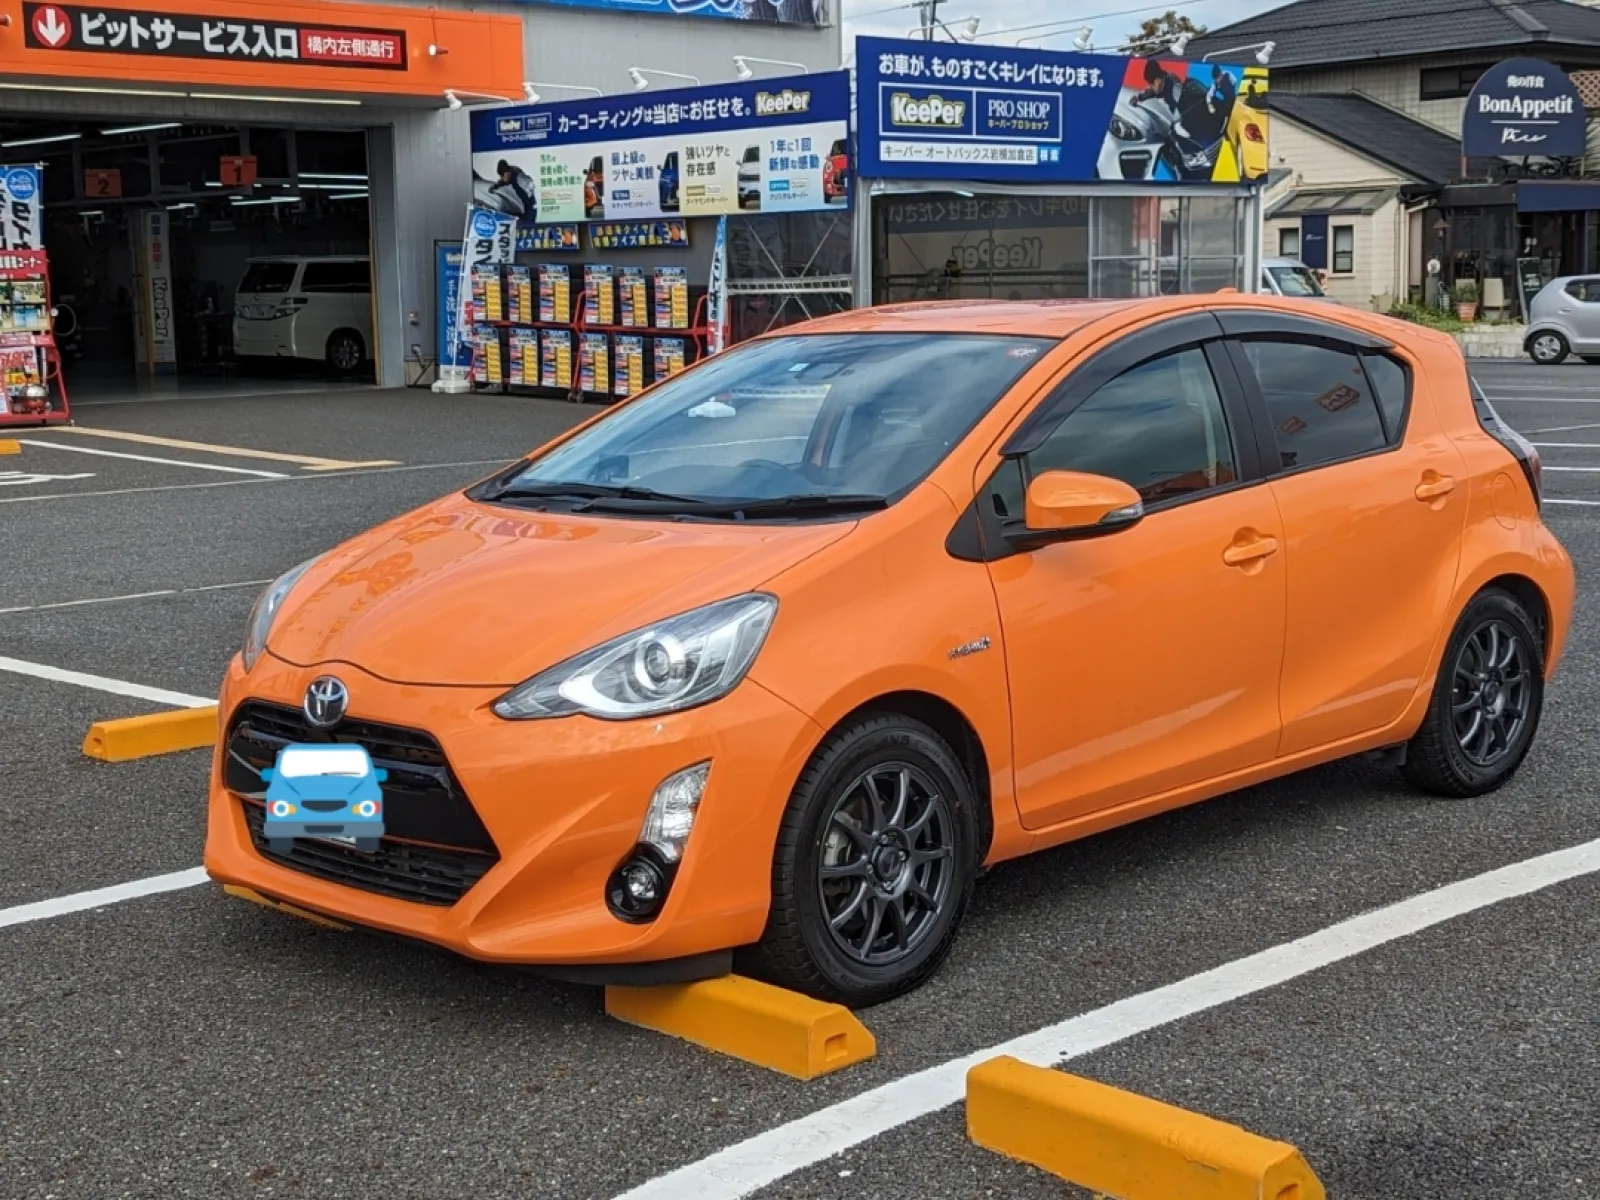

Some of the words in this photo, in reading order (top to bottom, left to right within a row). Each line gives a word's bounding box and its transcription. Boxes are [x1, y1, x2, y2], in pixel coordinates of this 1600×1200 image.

[80, 12, 299, 59] ピットサービス入口
[306, 34, 396, 59] 構内左側通行
[878, 53, 1105, 88] お車が、ものすごくキレイになります。
[754, 89, 811, 116] KeePer
[891, 92, 966, 127] KeePer
[987, 98, 1014, 118] PRO
[1016, 100, 1051, 119] SHOP
[1478, 94, 1574, 119] BonAppetit
[557, 98, 751, 134] カーコーティングは当店にお任せを。
[987, 118, 1050, 131] キーパープロショップ
[685, 144, 731, 160] 強いツヤと
[769, 137, 812, 154] 1年に1回
[883, 144, 923, 158] キーパー
[768, 154, 820, 172] 新鮮な感動
[1039, 149, 1061, 162] 検索
[234, 165, 243, 183] 1
[685, 161, 717, 177] 存在感
[97, 178, 109, 194] 2
[152, 277, 169, 338] KeePer
